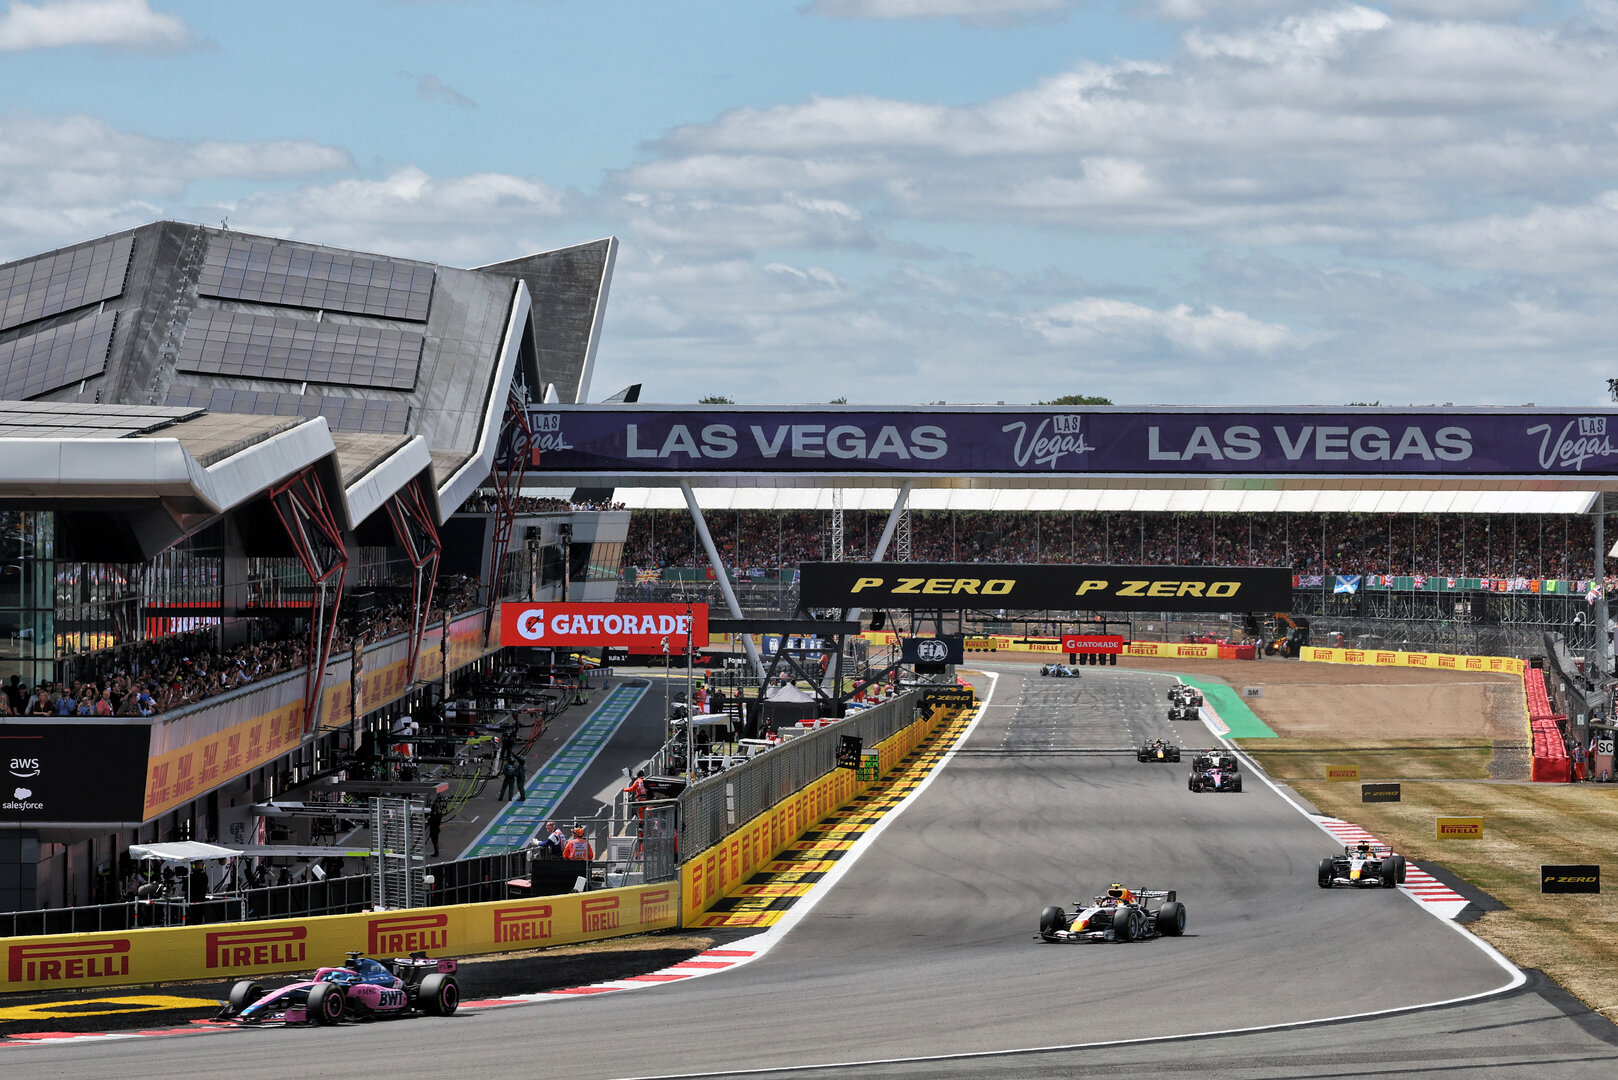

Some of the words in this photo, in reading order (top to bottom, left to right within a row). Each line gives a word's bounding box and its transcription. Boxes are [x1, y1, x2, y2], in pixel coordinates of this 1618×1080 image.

[534, 415, 559, 430] LAS
[1055, 416, 1080, 433] LAS
[1579, 418, 1605, 434] LAS
[627, 424, 738, 458] LAS
[750, 424, 947, 460] VEGAS
[1002, 418, 1095, 470] Vegas
[1149, 426, 1261, 460] LAS
[1273, 426, 1473, 461] VEGAS
[1527, 421, 1618, 471] Vegas
[850, 577, 884, 594] P
[891, 577, 1016, 595] ZERO
[1075, 579, 1109, 596] P
[1116, 580, 1242, 597] ZERO
[551, 614, 690, 635] GATORADE
[920, 644, 944, 658] FIA
[1599, 742, 1613, 753] SC
[10, 758, 39, 769] aws
[2, 801, 43, 811] salesforce
[1441, 824, 1478, 835] PIRELLI
[1544, 876, 1555, 884] P
[1557, 876, 1597, 884] ZERO
[494, 904, 553, 943] PIRELLI
[582, 896, 620, 933] PIRELLI
[368, 914, 448, 955] PIRELLI
[206, 926, 307, 968] PIRELLI
[8, 939, 131, 982] PIRELLI
[378, 990, 404, 1008] BWT
